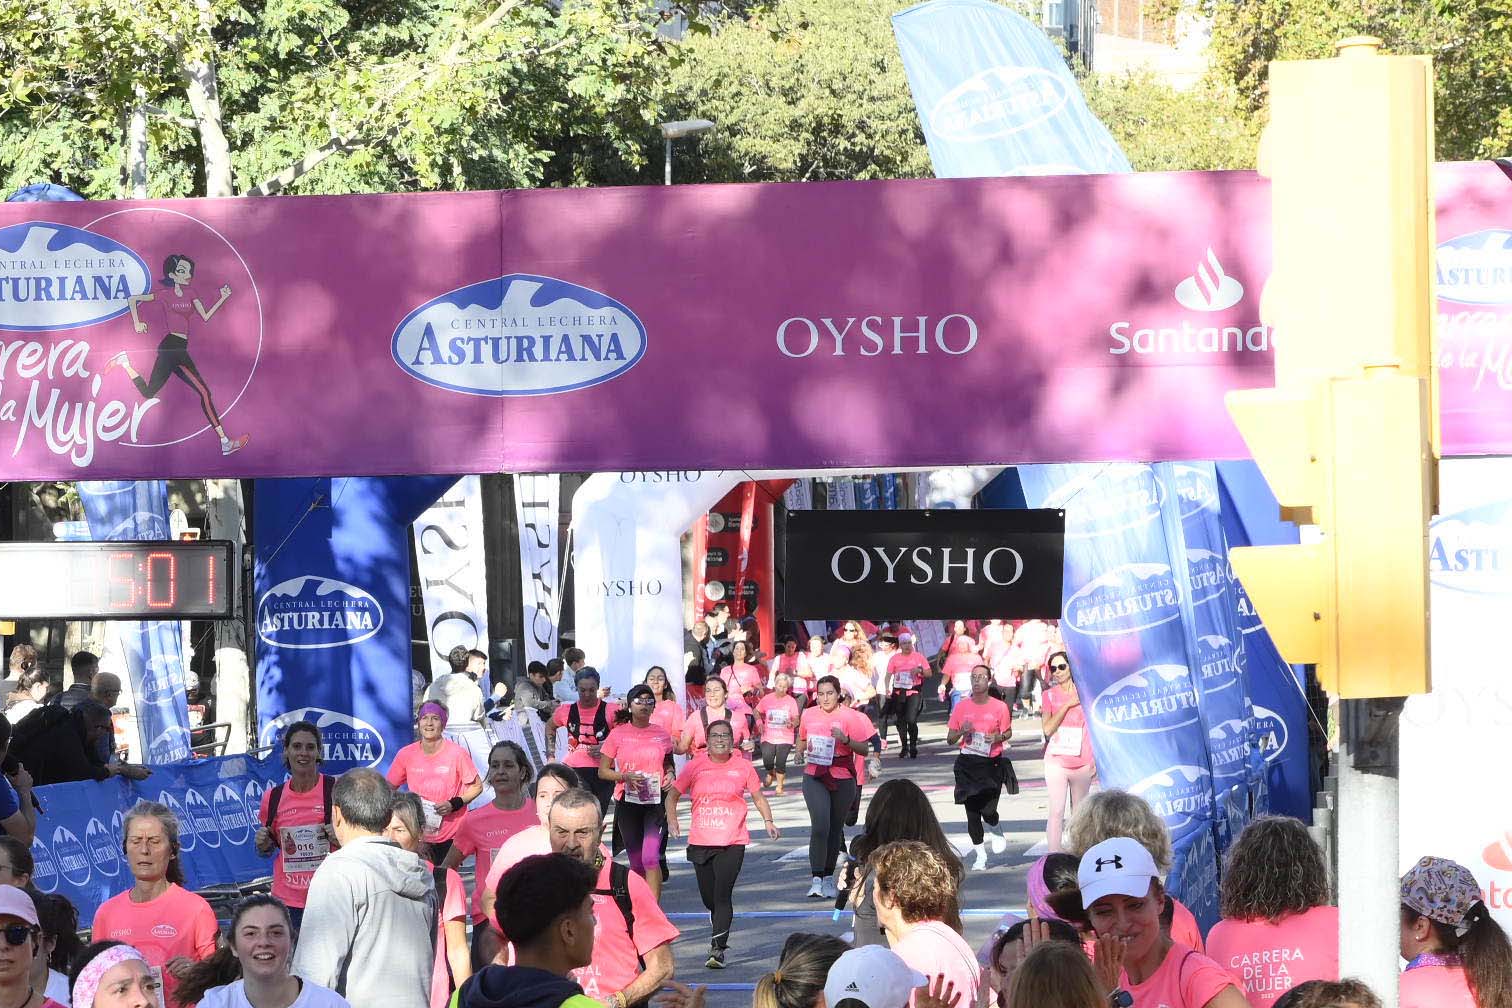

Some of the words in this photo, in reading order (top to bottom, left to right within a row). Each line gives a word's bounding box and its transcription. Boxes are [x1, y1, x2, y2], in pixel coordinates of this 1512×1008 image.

[53, 258, 126, 271] LECHERA
[450, 316, 530, 330] CENTRAL
[538, 314, 619, 328] LECHERA
[412, 321, 628, 365] ASTURIANA
[776, 313, 979, 358] OYSHO
[1109, 319, 1276, 356] Santand
[11, 373, 161, 468] Mujer
[830, 545, 1023, 587] OYSHO
[273, 599, 317, 610] CENTRAL
[320, 599, 369, 609] LECHERA
[260, 606, 374, 633] ASTURIANA
[321, 732, 369, 741] LECHERA
[297, 842, 315, 851] 016
[285, 872, 311, 886] SUM
[1230, 948, 1305, 969] CARRERA
[1243, 965, 1263, 980] DE
[1269, 963, 1289, 976] LA
[1241, 976, 1292, 993] MUJER
